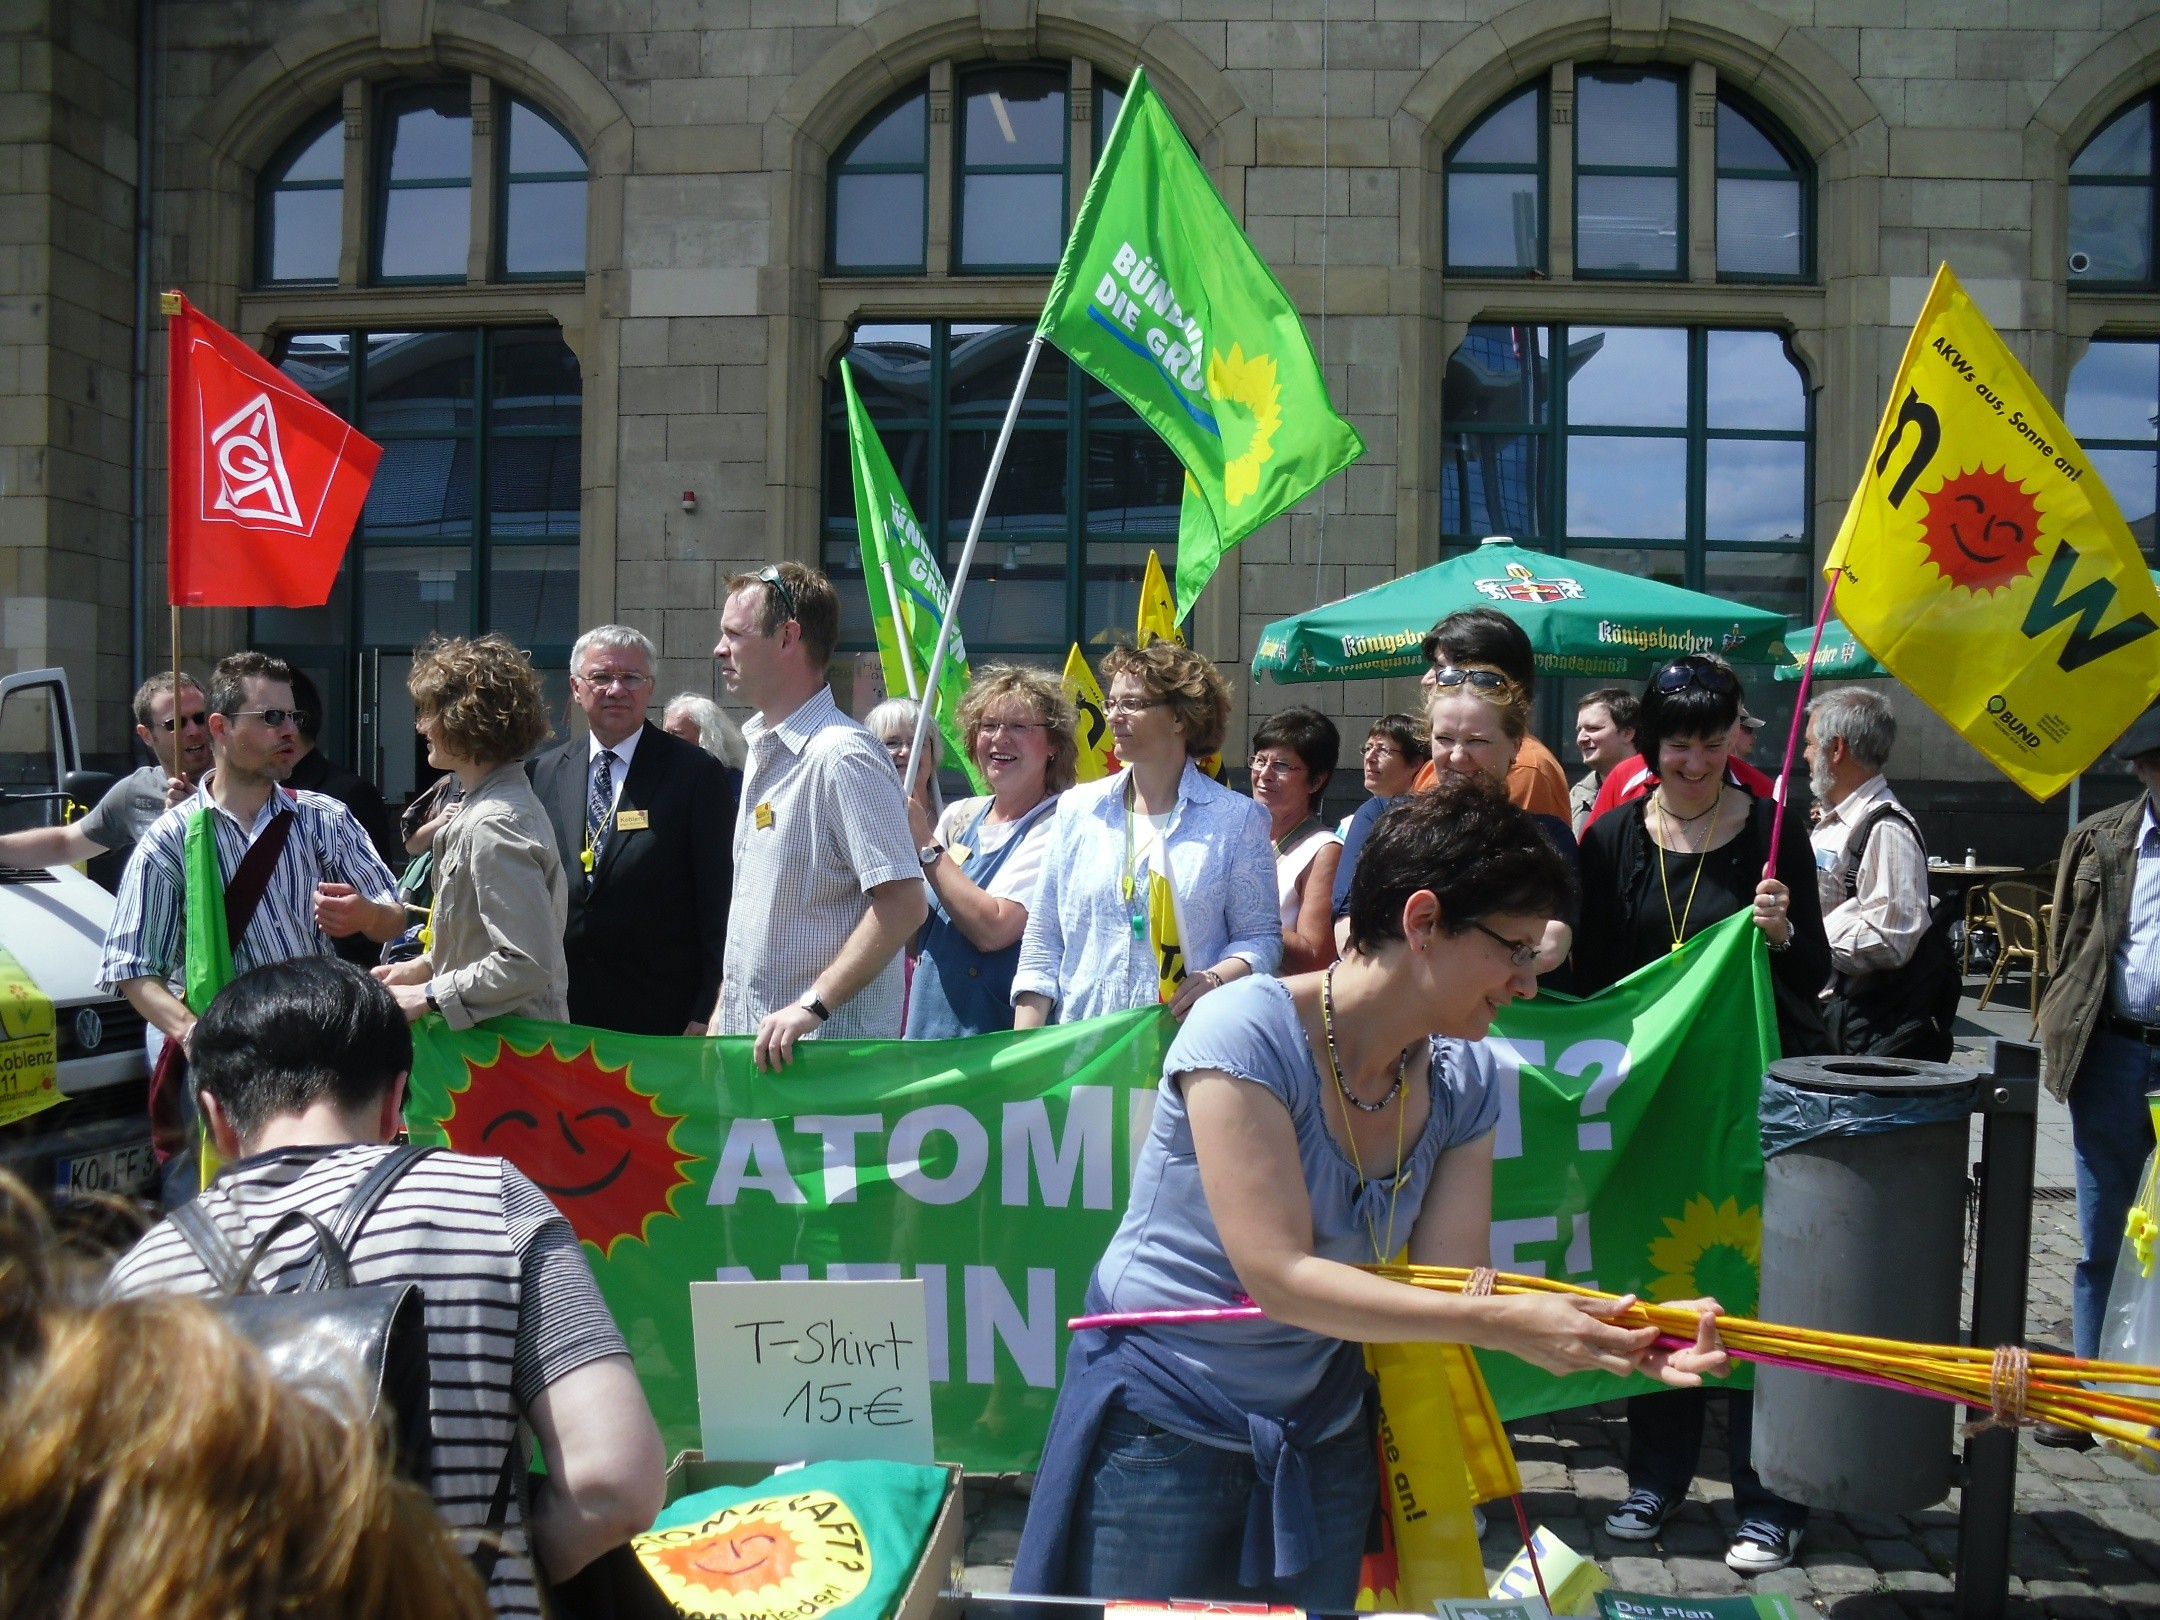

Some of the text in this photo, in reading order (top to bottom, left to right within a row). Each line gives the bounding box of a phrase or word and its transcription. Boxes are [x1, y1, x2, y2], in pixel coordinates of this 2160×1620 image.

[1095, 272, 1141, 331] DIE
[1932, 337, 2083, 482] AKWs aus, Sonne an!
[1598, 619, 1713, 655] Königsbacher
[2000, 710, 2041, 748] BUND
[71, 1159, 99, 1196] KO
[735, 1319, 913, 1370] T-Shirt
[1394, 1472, 1427, 1523] an!
[1615, 1600, 1655, 1616] Der
[1661, 1607, 1714, 1620] Plan
